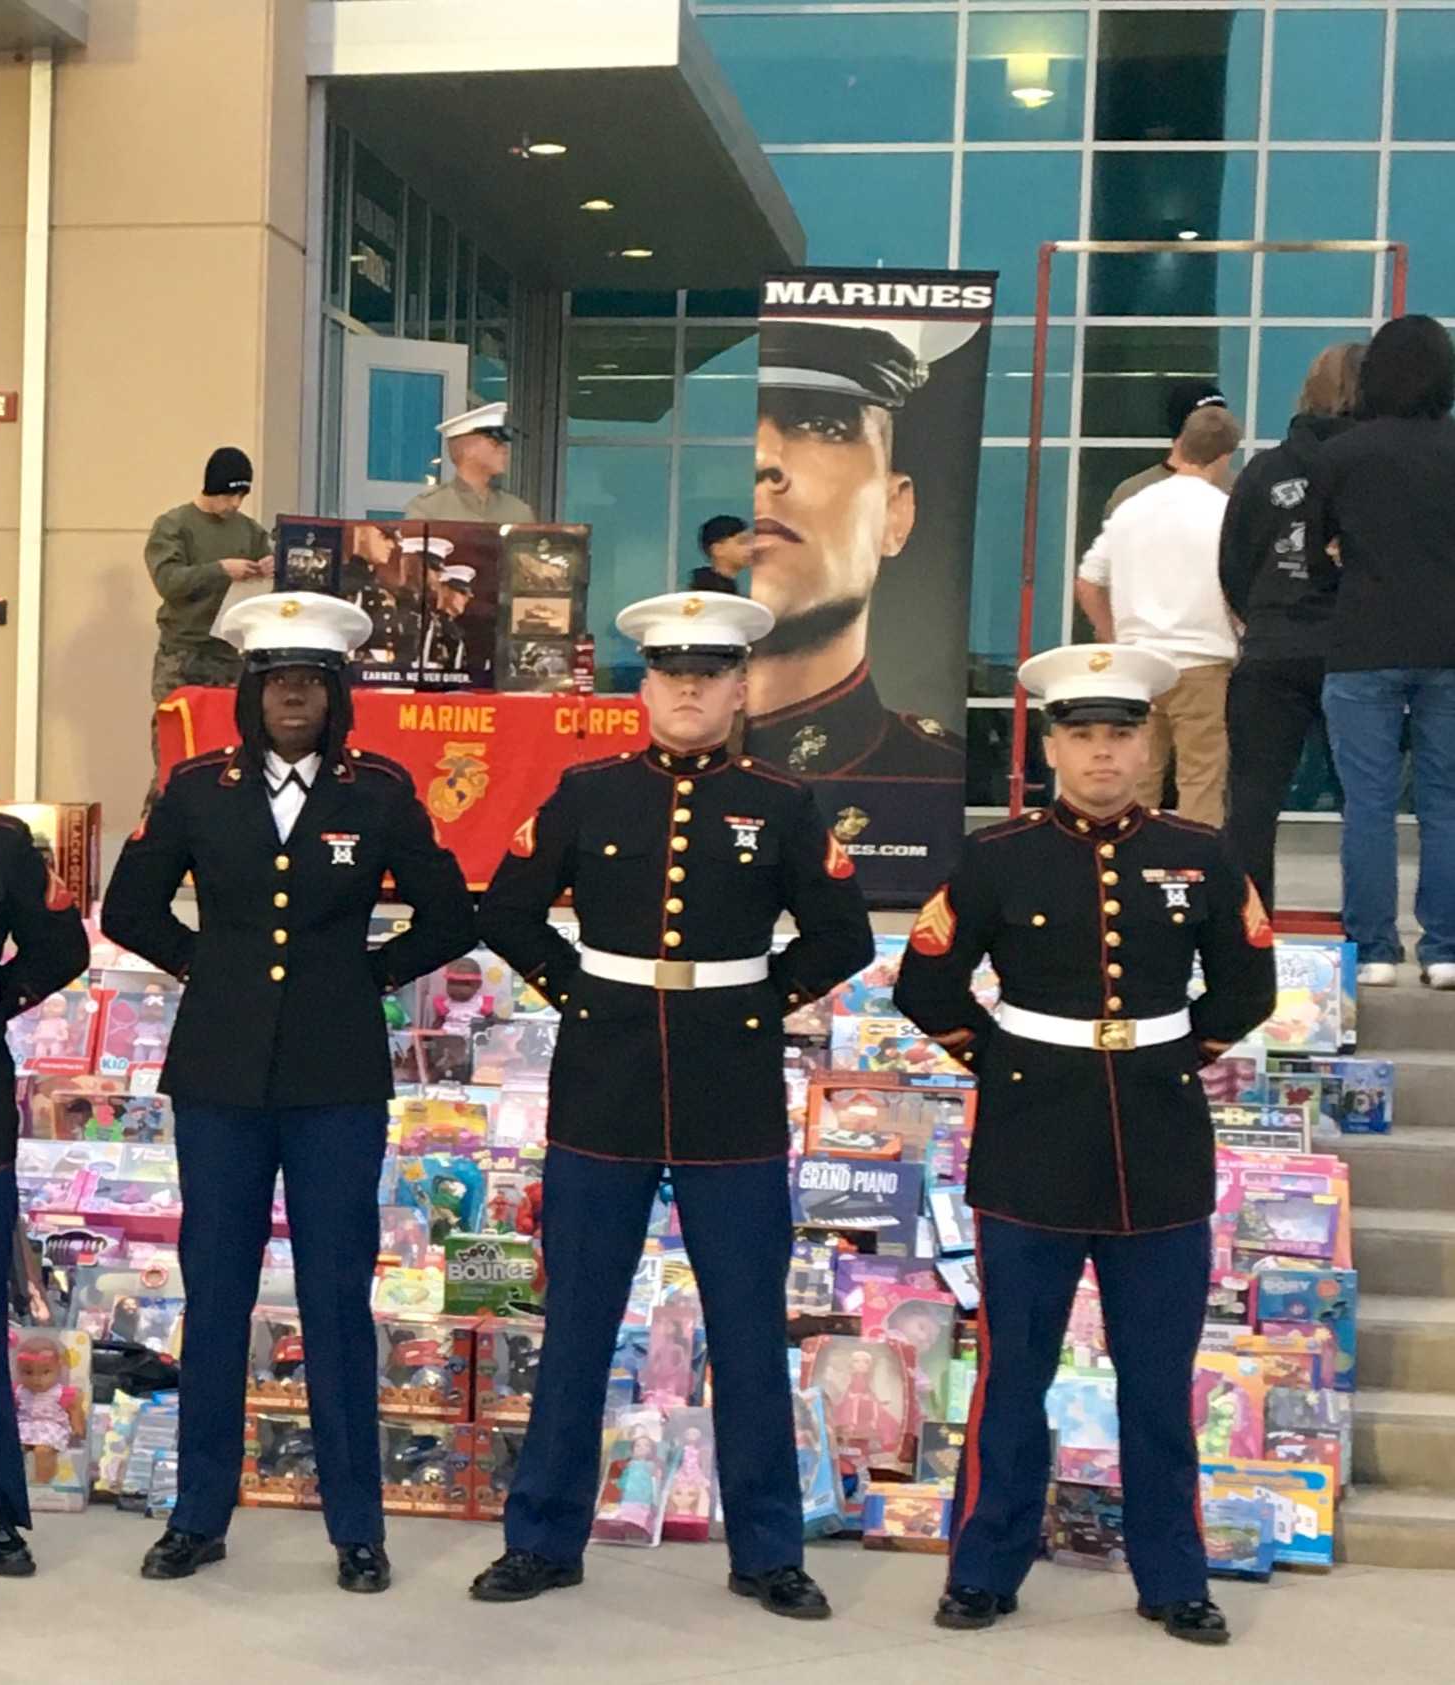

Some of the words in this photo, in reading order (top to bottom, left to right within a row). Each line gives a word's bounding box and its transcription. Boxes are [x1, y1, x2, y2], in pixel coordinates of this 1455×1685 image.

[764, 281, 993, 309] MARINES
[399, 703, 497, 733] MARINE
[844, 843, 928, 857] ES.COM
[101, 1056, 128, 1070] KID
[799, 1167, 851, 1192] GRAND
[853, 1171, 898, 1194] PIANO
[448, 1261, 536, 1280] BOUNCE
